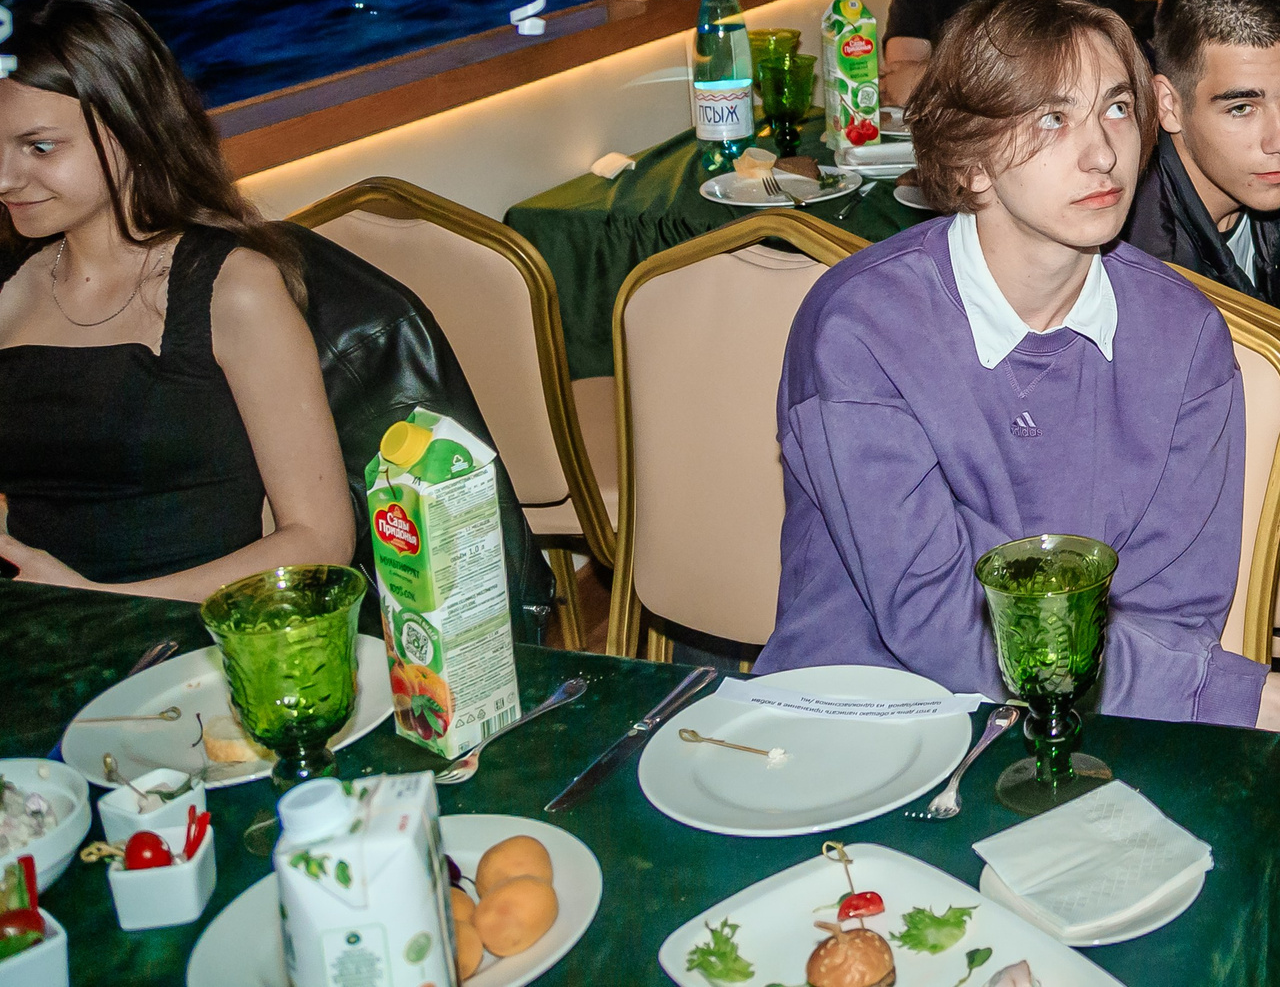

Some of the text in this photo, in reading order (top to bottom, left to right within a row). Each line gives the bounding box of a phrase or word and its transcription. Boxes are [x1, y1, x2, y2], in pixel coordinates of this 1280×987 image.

[698, 104, 740, 124] ПСЫЖ
[378, 518, 417, 546] Придонья
[386, 512, 410, 532] Сады
